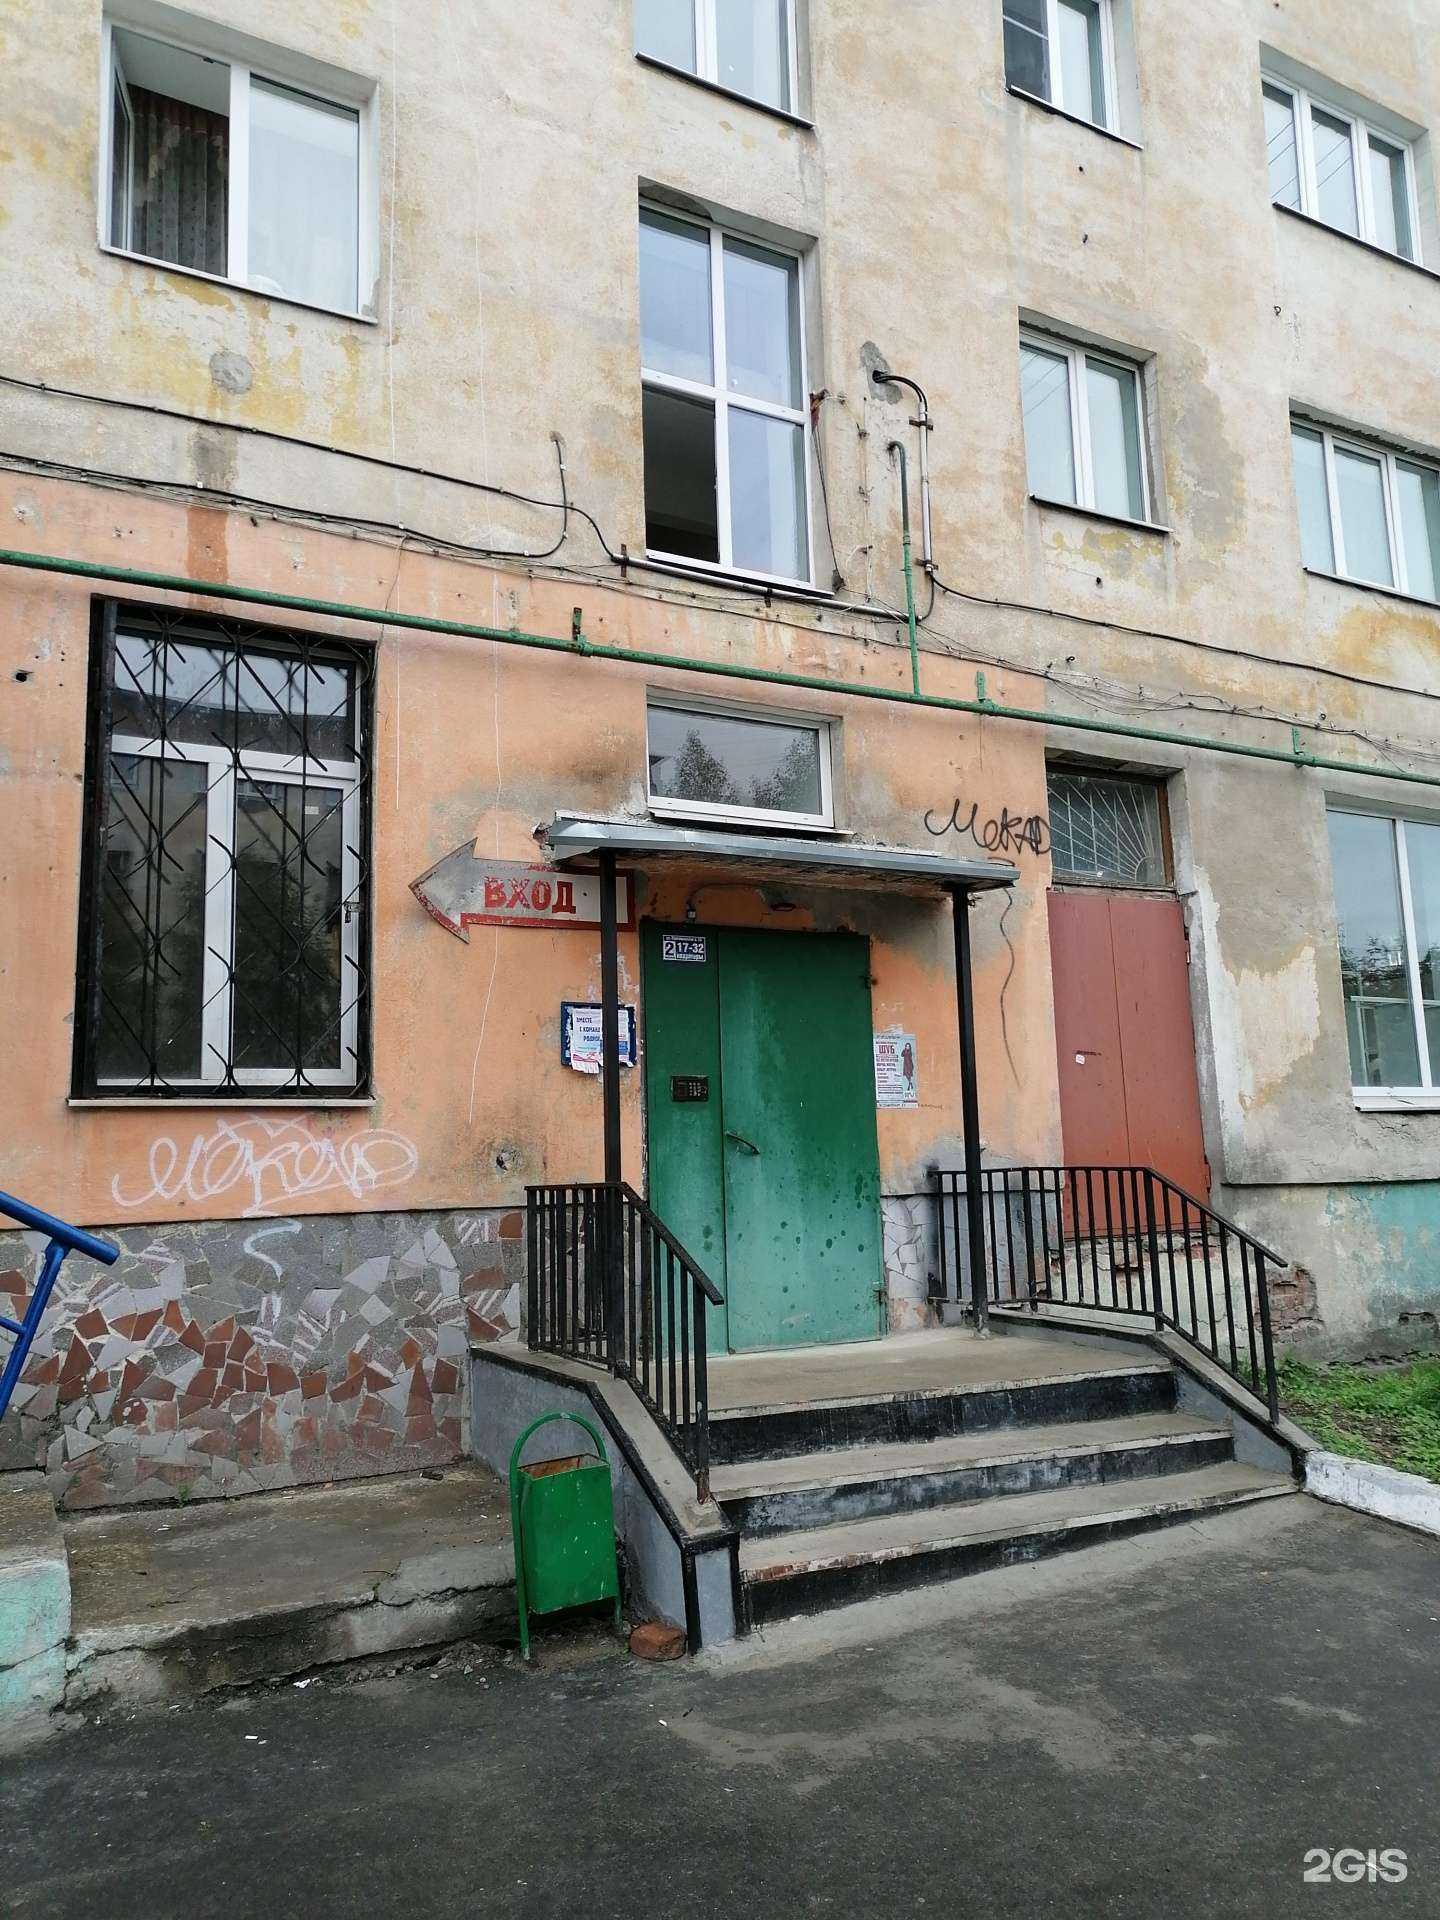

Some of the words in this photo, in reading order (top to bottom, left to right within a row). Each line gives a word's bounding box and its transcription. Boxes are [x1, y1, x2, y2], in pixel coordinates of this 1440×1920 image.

[484, 876, 577, 914] ВХОД
[665, 942, 674, 955] 2
[677, 942, 704, 953] 17-32
[879, 1044, 895, 1054] ШУБ
